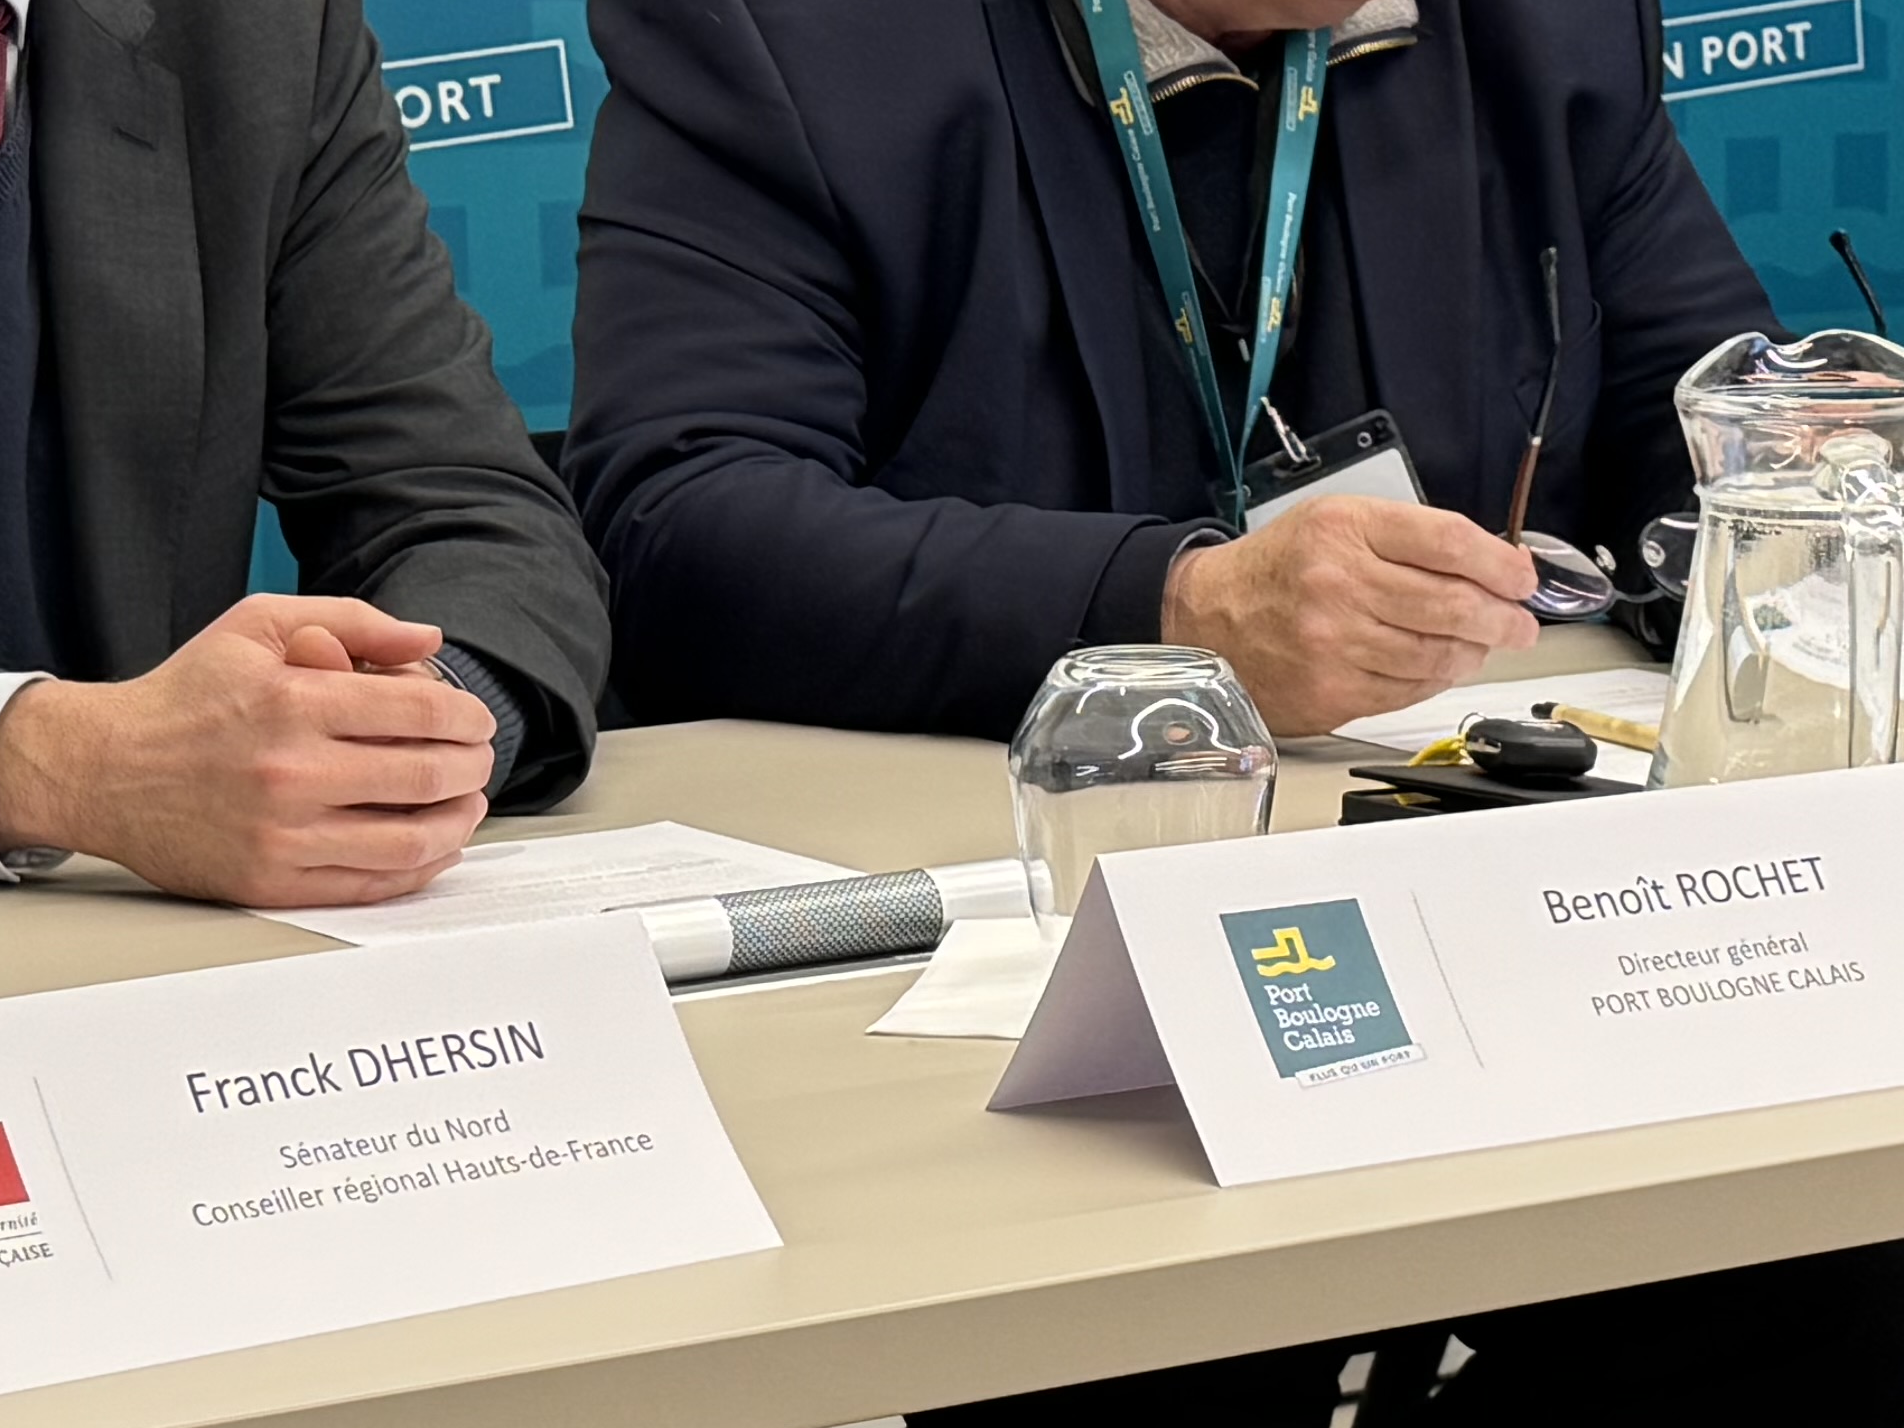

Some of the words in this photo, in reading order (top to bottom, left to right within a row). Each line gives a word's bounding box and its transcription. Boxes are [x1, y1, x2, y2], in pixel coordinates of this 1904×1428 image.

[1702, 22, 1811, 75] PORT
[395, 74, 501, 128] ORT
[1543, 876, 1672, 923] Benoît
[1676, 857, 1824, 907] ROCHET
[1618, 948, 1719, 976] Directeur
[1727, 932, 1808, 966] général
[1264, 983, 1313, 1005] Port
[1273, 1001, 1380, 1028] Boulogne
[1592, 990, 1650, 1016] PORT
[1657, 972, 1784, 1007] BOULOGNE
[1788, 962, 1865, 989] CALAIS
[1283, 1026, 1355, 1051] Calais
[187, 1053, 342, 1113] Franck
[348, 1022, 544, 1087] DHERSIN
[280, 1134, 396, 1168] Sénateur
[407, 1123, 440, 1147] du
[445, 1109, 510, 1140] Nord
[192, 1187, 323, 1226] Conseiller
[333, 1163, 440, 1203] régional
[443, 1134, 653, 1183] Hauts-de-France
